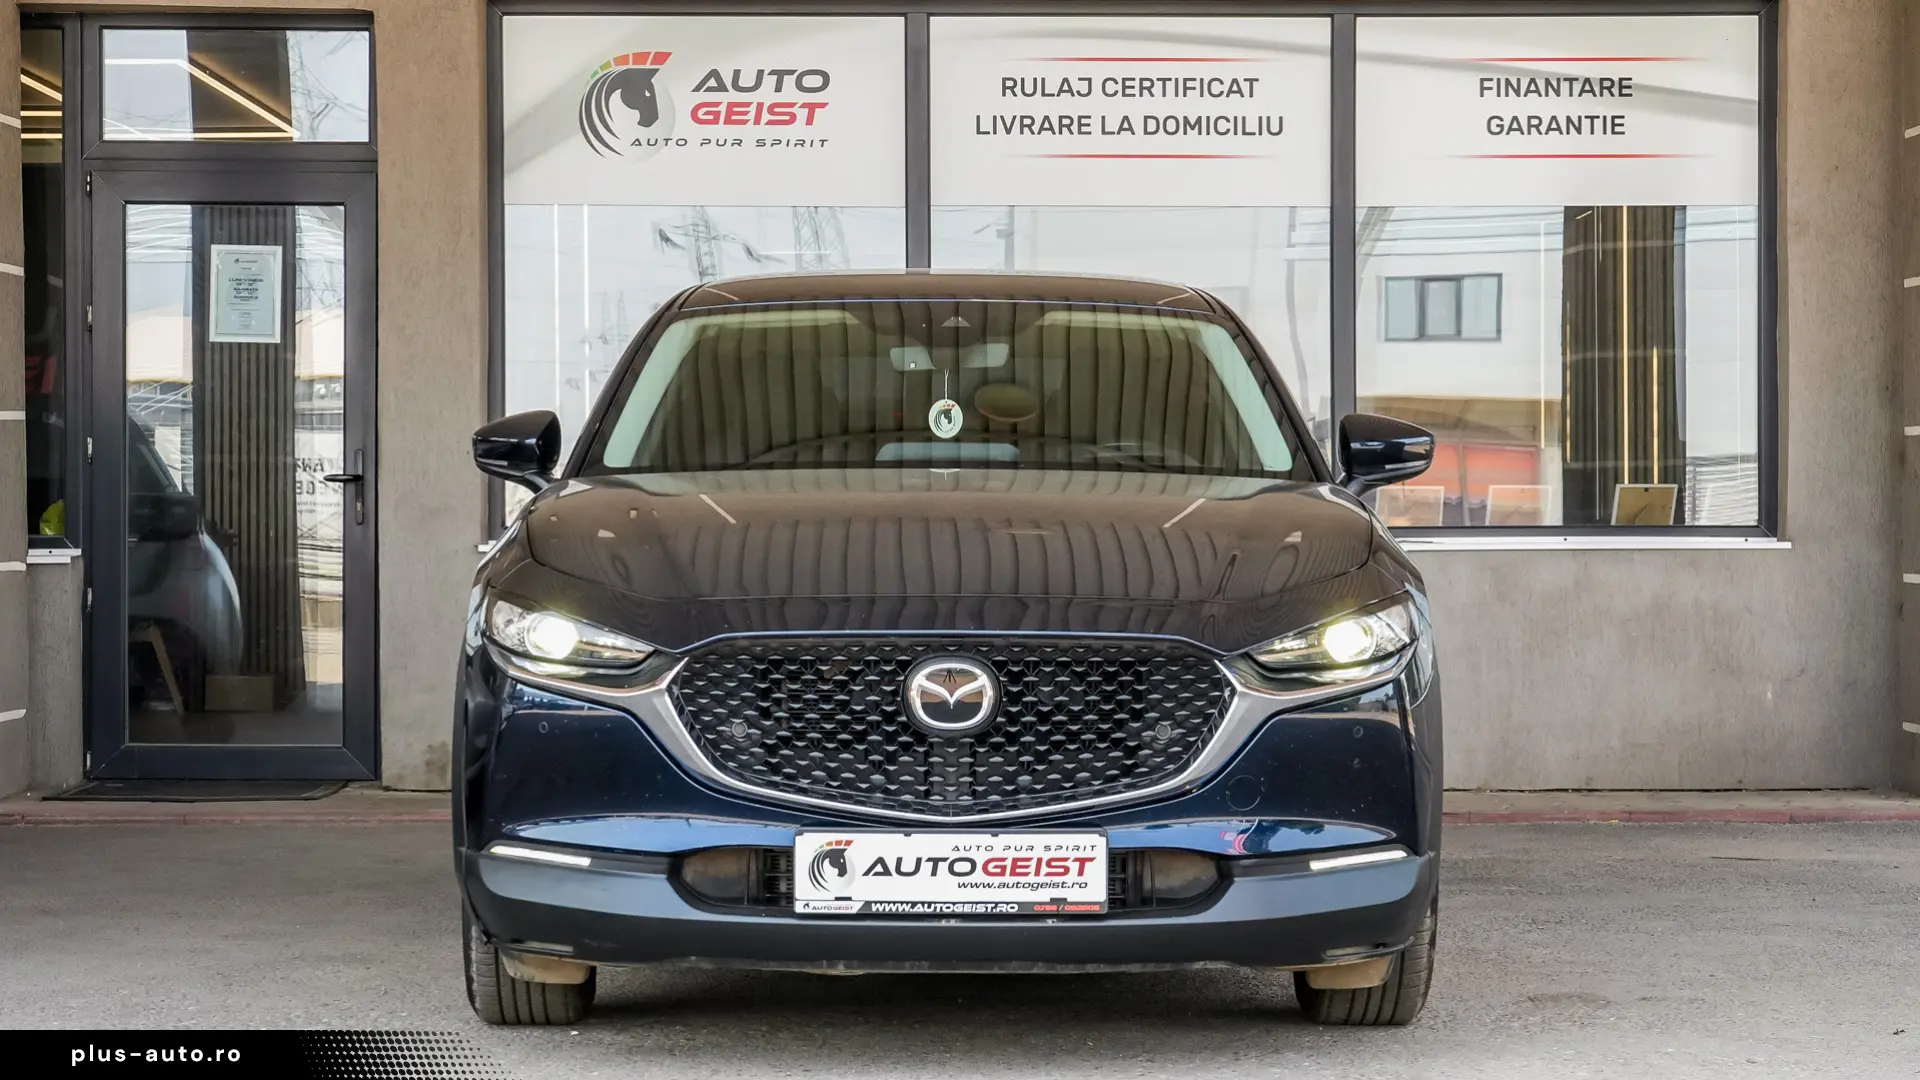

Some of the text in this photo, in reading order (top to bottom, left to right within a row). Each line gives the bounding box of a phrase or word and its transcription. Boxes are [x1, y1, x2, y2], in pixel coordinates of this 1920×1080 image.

[690, 68, 831, 94] AUTO
[1000, 76, 1260, 98] RULAJ CERTIFICAT
[1479, 77, 1633, 98] FINANTARE
[690, 101, 830, 126] GEIST
[975, 114, 1284, 136] LIVRARE LA DOMICILIU
[1486, 115, 1626, 136] GARANTIE
[630, 137, 829, 148] AUTO PUR SPIRIT
[957, 880, 1088, 892] www.autogeist.ro
[871, 902, 1019, 913] WWW.AUTOGEIST.RO
